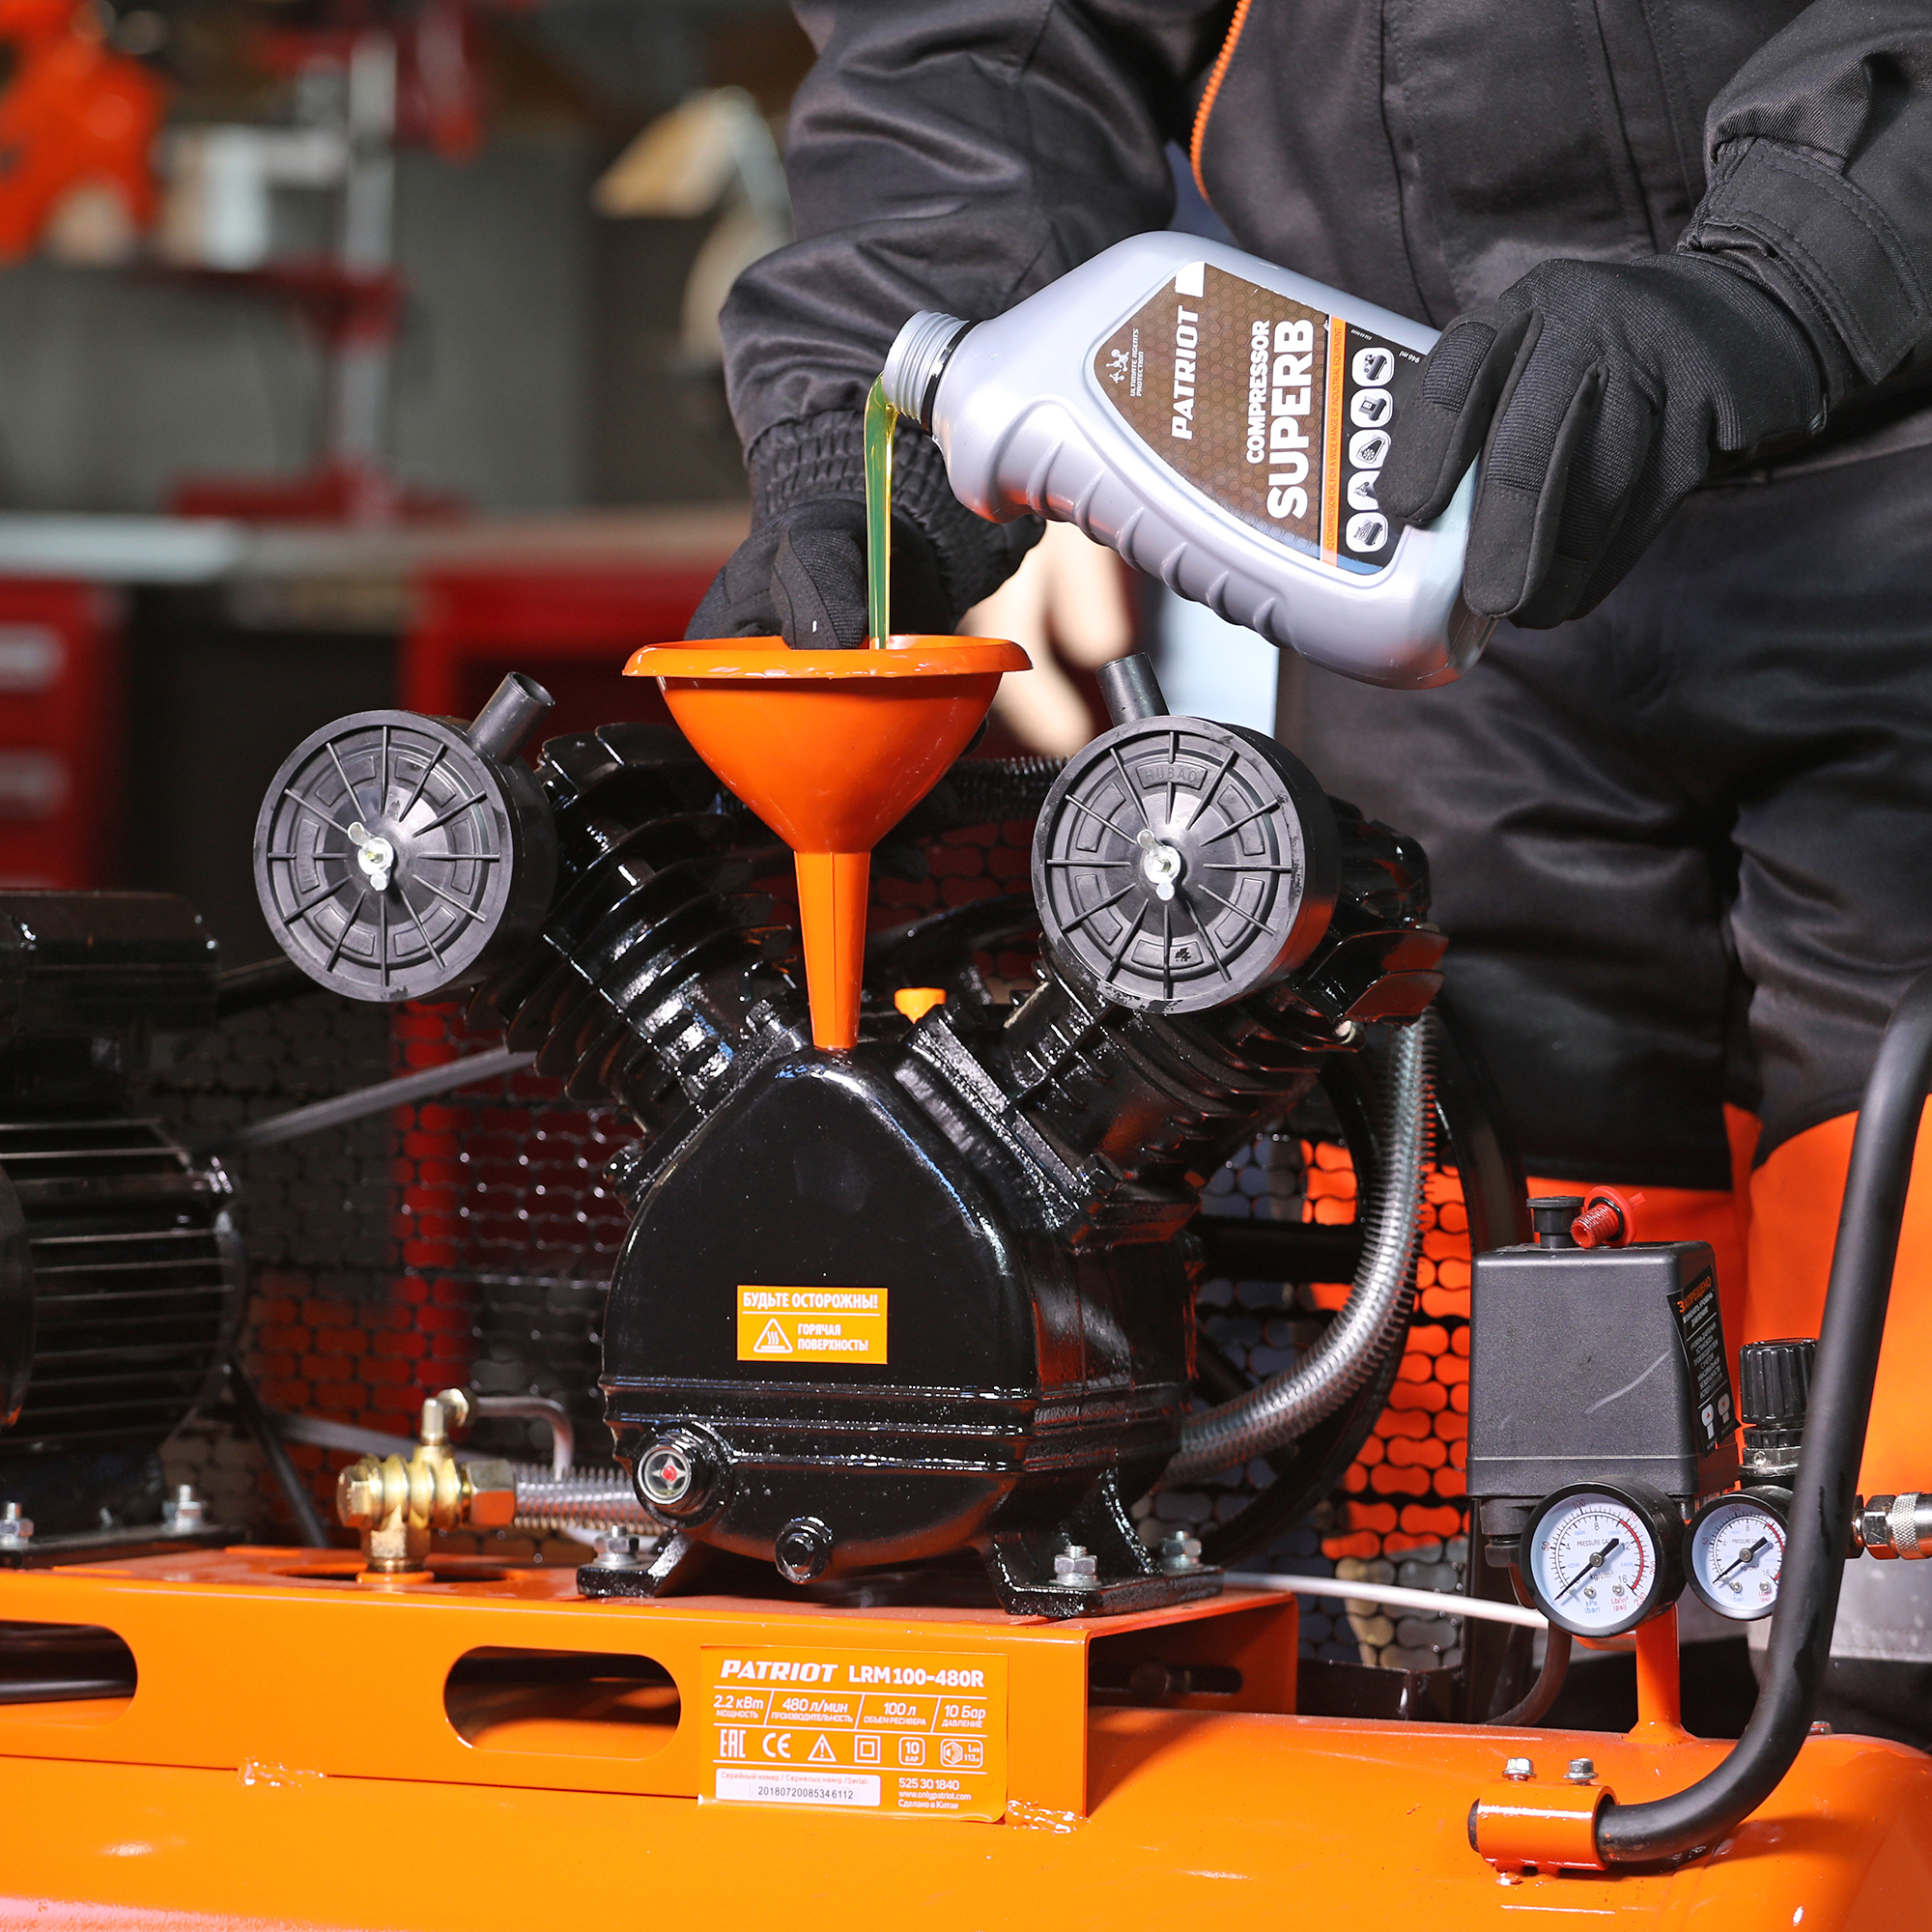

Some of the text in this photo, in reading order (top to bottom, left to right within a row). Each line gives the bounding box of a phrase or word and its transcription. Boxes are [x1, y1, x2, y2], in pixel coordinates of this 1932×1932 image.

[1333, 327, 1342, 365] EQUIPMENT
[1136, 351, 1145, 397] PROTECTION
[1171, 304, 1200, 440] PATRIOT
[1245, 319, 1272, 465] COMPRESSOR
[1331, 367, 1341, 406] INDUSTRIAL
[1266, 319, 1315, 519] SUPERB
[1331, 407, 1339, 417] OF
[1330, 418, 1339, 441] RANGE
[1329, 441, 1338, 460] WIDE
[1328, 468, 1337, 482] FOR
[1328, 483, 1337, 495] OIL
[1327, 495, 1337, 541] COMPRESSOR
[1145, 766, 1197, 783] HUBAO
[743, 1292, 879, 1310] БУДЬТЕ ОСТОРОЖНЫ!
[1677, 1275, 1712, 1314] ЗАПРЕЩЕНО
[797, 1322, 841, 1336] ГОРЯЧАЯ
[797, 1338, 869, 1351] ПОВЕРХНОСТЬ!
[1573, 1498, 1586, 1509] 100
[1594, 1521, 1600, 1531] 8
[1577, 1538, 1601, 1548] PRESSURE
[1618, 1575, 1628, 1583] 16
[720, 1660, 838, 1683] PATRIOT
[713, 1694, 734, 1709] 2.2
[781, 1697, 809, 1712] 480
[883, 1701, 906, 1716] 100
[716, 1709, 759, 1719] МОЩНОСТЬ
[771, 1712, 854, 1723] ПРОИЗВОДИТЕЛЬНОСТЬ
[944, 1704, 986, 1720] 10 Бар
[863, 1716, 926, 1725] ОБЪЕМ РЕСИВЕРА
[941, 1719, 983, 1728] ДАВЛЕНИЕ
[904, 1741, 920, 1754] 10
[721, 1772, 757, 1780] Серийный
[898, 1776, 960, 1791] 525 30 1840
[897, 1790, 972, 1801] www.onlypatriot.com
[897, 1799, 930, 1808] Сделано
[936, 1801, 959, 1810] Китае
